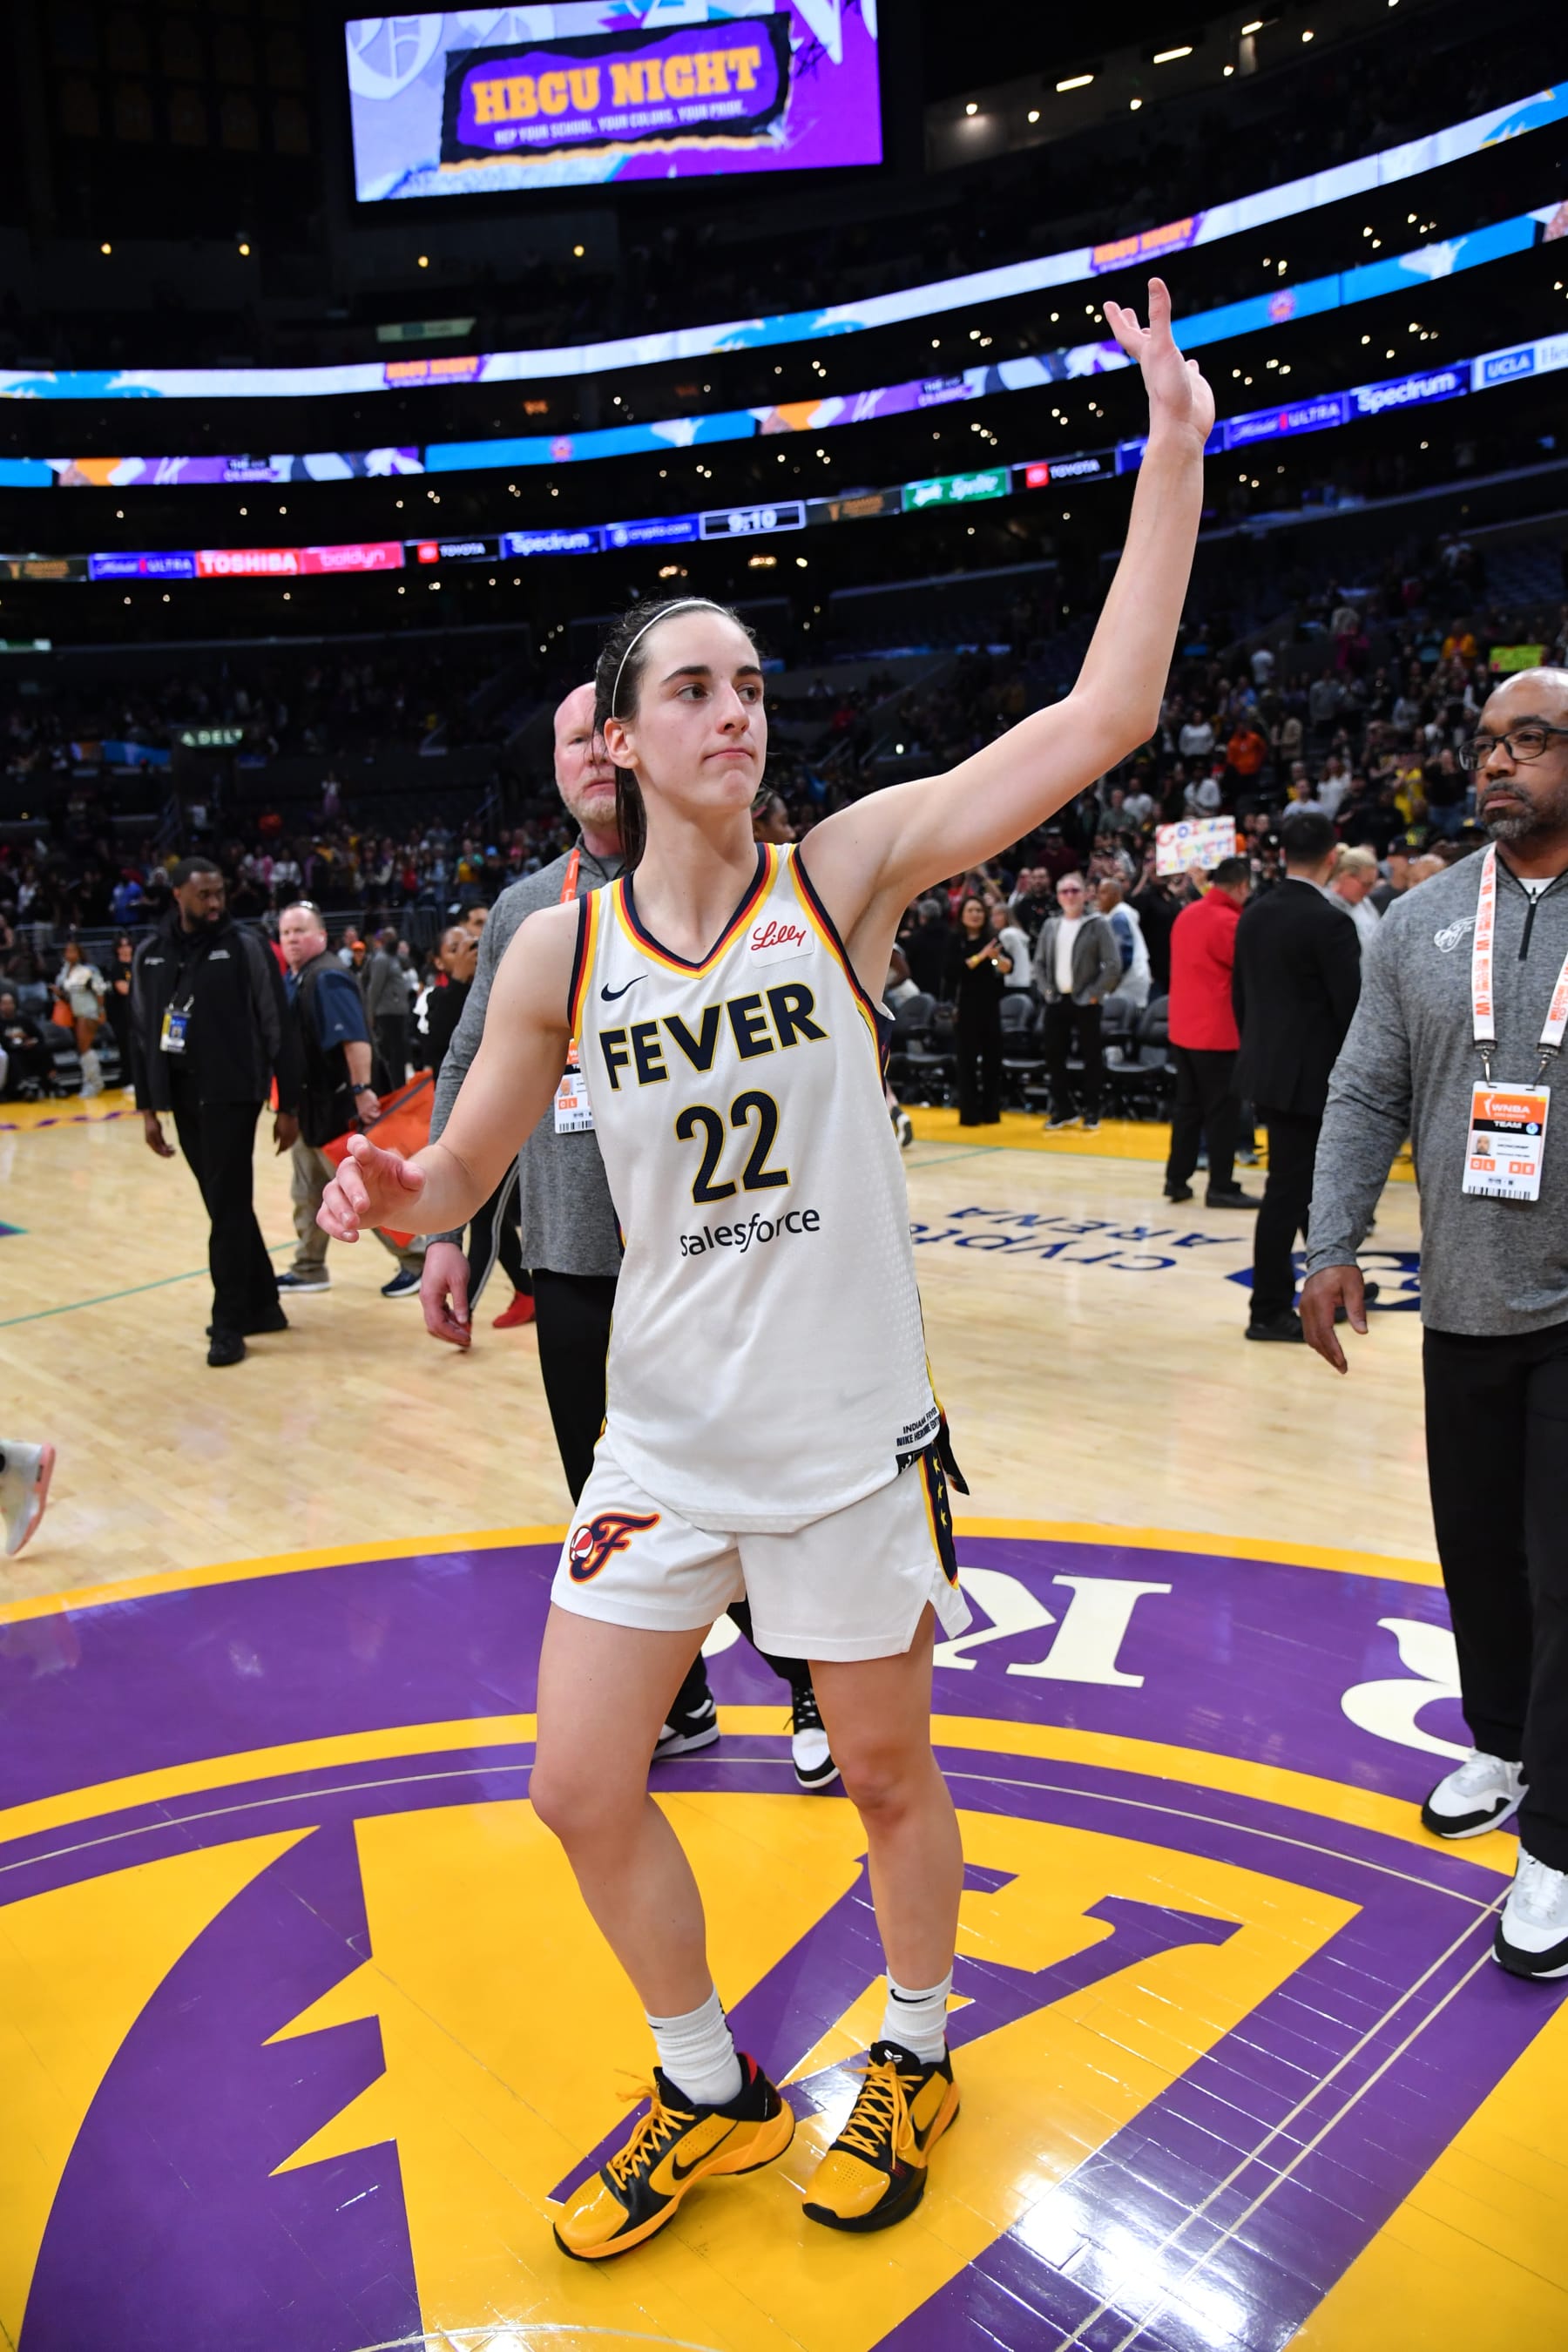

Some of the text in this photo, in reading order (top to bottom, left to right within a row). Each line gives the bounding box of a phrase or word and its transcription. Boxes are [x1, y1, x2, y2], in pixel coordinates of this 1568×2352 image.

[472, 45, 761, 125] HBCU NIGHT
[517, 125, 550, 143] YOUR
[597, 114, 628, 133] YOUR
[677, 104, 709, 123] YOUR
[1487, 354, 1531, 378] UCLA
[1357, 372, 1456, 415] Spectrum
[1288, 402, 1341, 427] ULTRA
[1050, 458, 1100, 479] TOYOTA
[949, 474, 998, 500] Sprite
[728, 510, 777, 533] 9:10
[440, 542, 485, 558] TOYOTA
[511, 532, 590, 556] Spectrum
[200, 551, 298, 574] TOSHIBA
[750, 921, 807, 951] Lilly
[598, 981, 831, 1092] FEVER
[1491, 1103, 1531, 1115] WNBA
[1493, 1120, 1523, 1129] TEAM
[673, 1088, 791, 1206] 22
[680, 1208, 821, 1257] salesforce
[946, 1206, 1247, 1247] ARENA
[896, 1433, 913, 1446] NIKE
